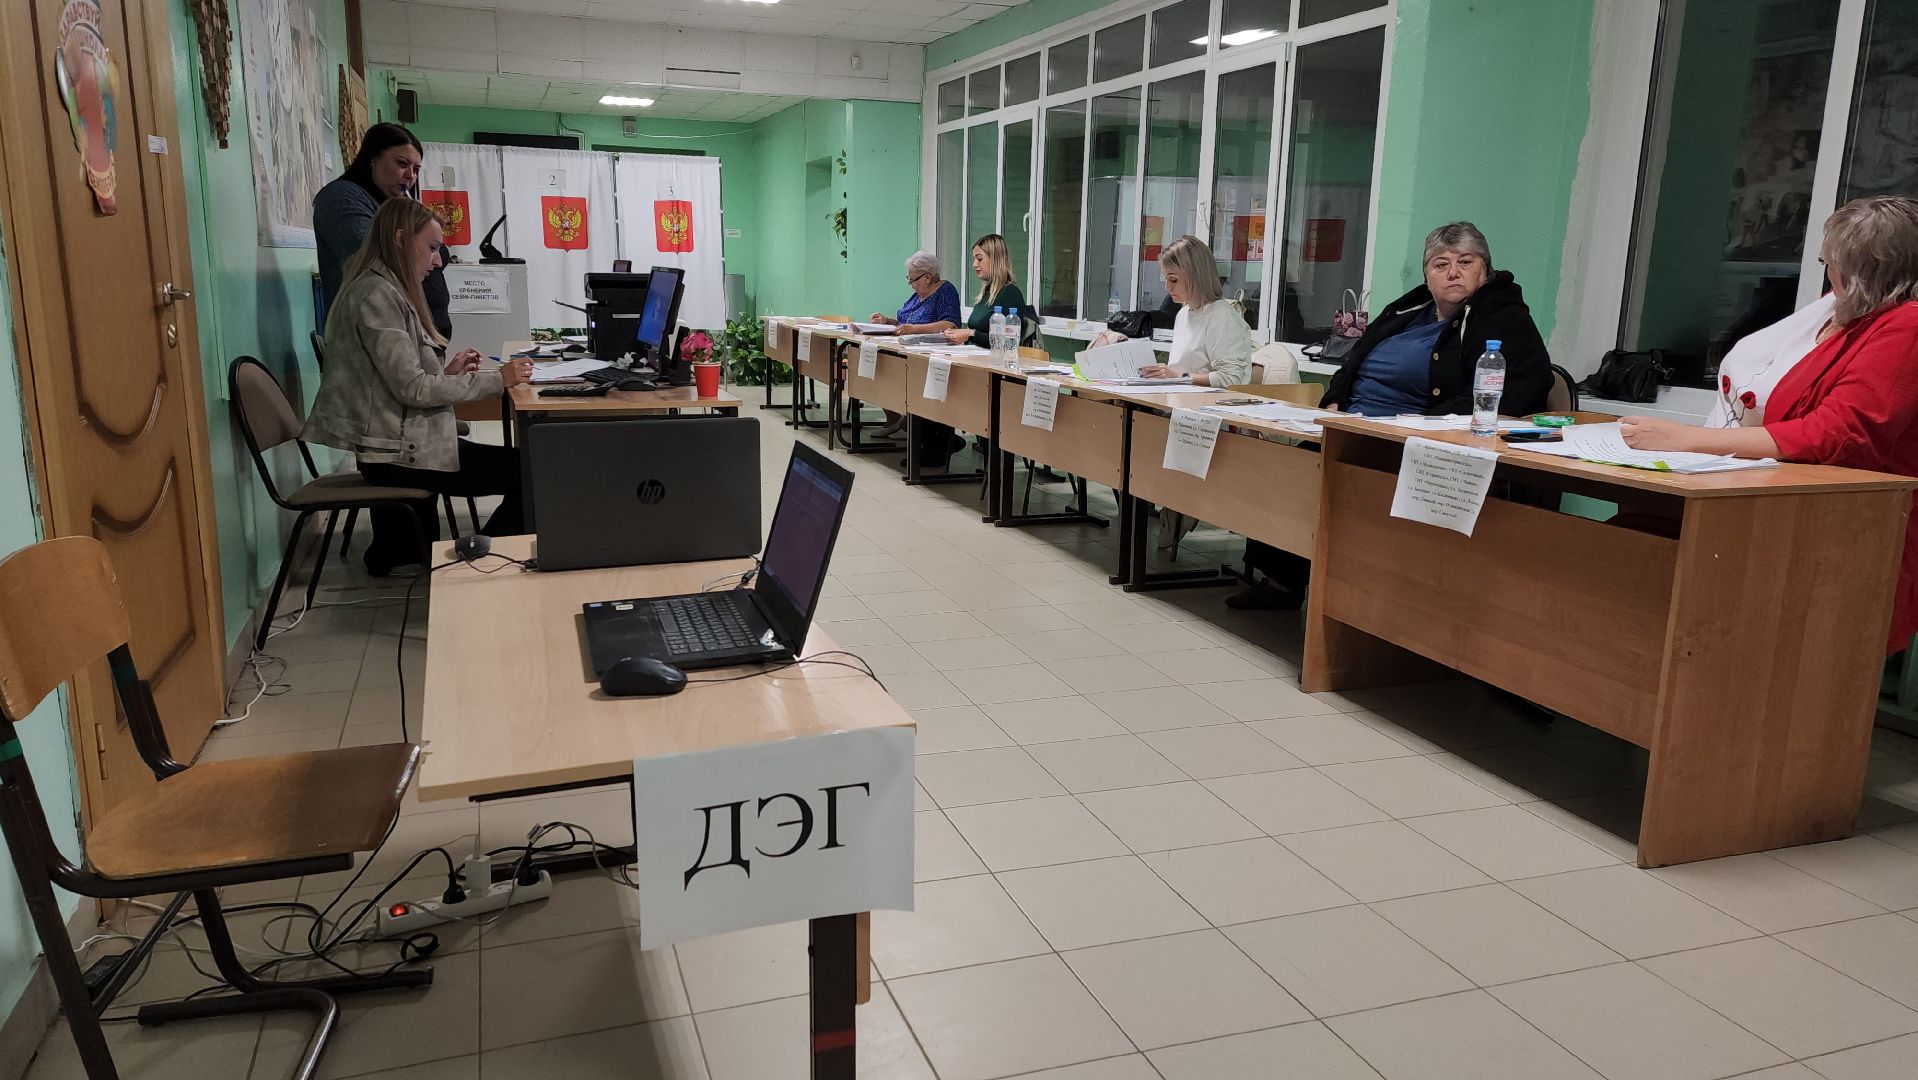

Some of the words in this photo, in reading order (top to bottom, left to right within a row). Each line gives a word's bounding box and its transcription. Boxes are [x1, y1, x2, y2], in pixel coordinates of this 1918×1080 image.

[440, 172, 446, 184] 1
[549, 174, 557, 186] 2
[667, 185, 675, 197] 3
[638, 480, 665, 505] hp
[683, 782, 871, 892] ДЭГ
